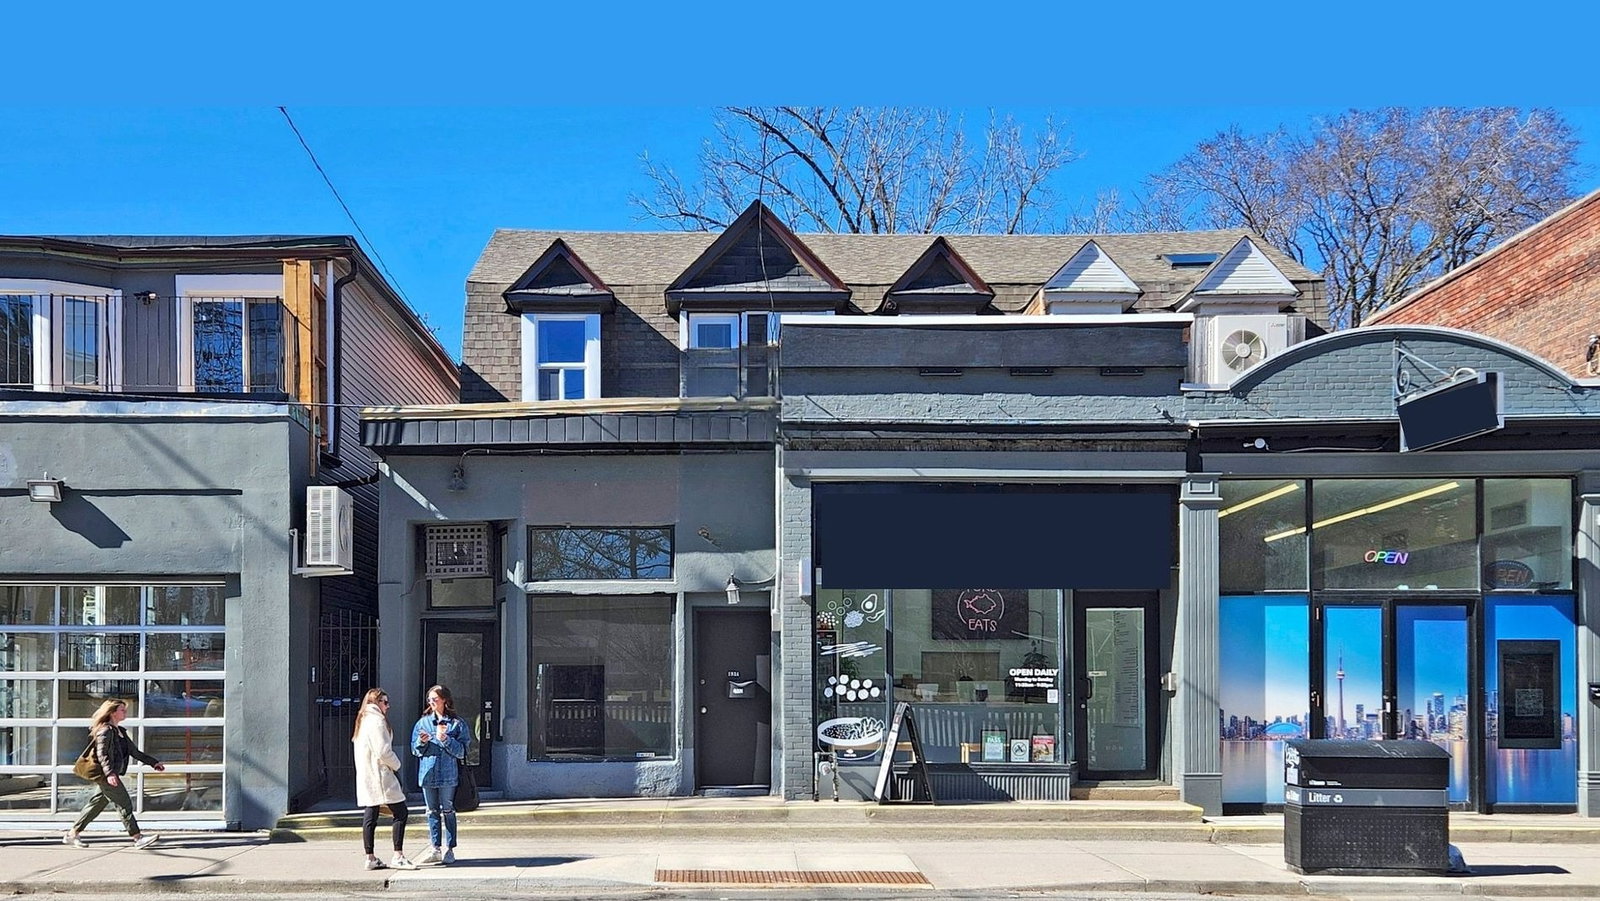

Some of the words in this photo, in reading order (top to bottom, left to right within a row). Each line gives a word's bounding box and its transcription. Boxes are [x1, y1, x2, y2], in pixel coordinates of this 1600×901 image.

[1364, 550, 1409, 564] OPEN
[1490, 568, 1530, 585] PEN
[968, 618, 997, 632] EATS
[1009, 668, 1033, 676] OPEN
[1034, 668, 1059, 676] DAILY
[1308, 791, 1331, 803] Litter
